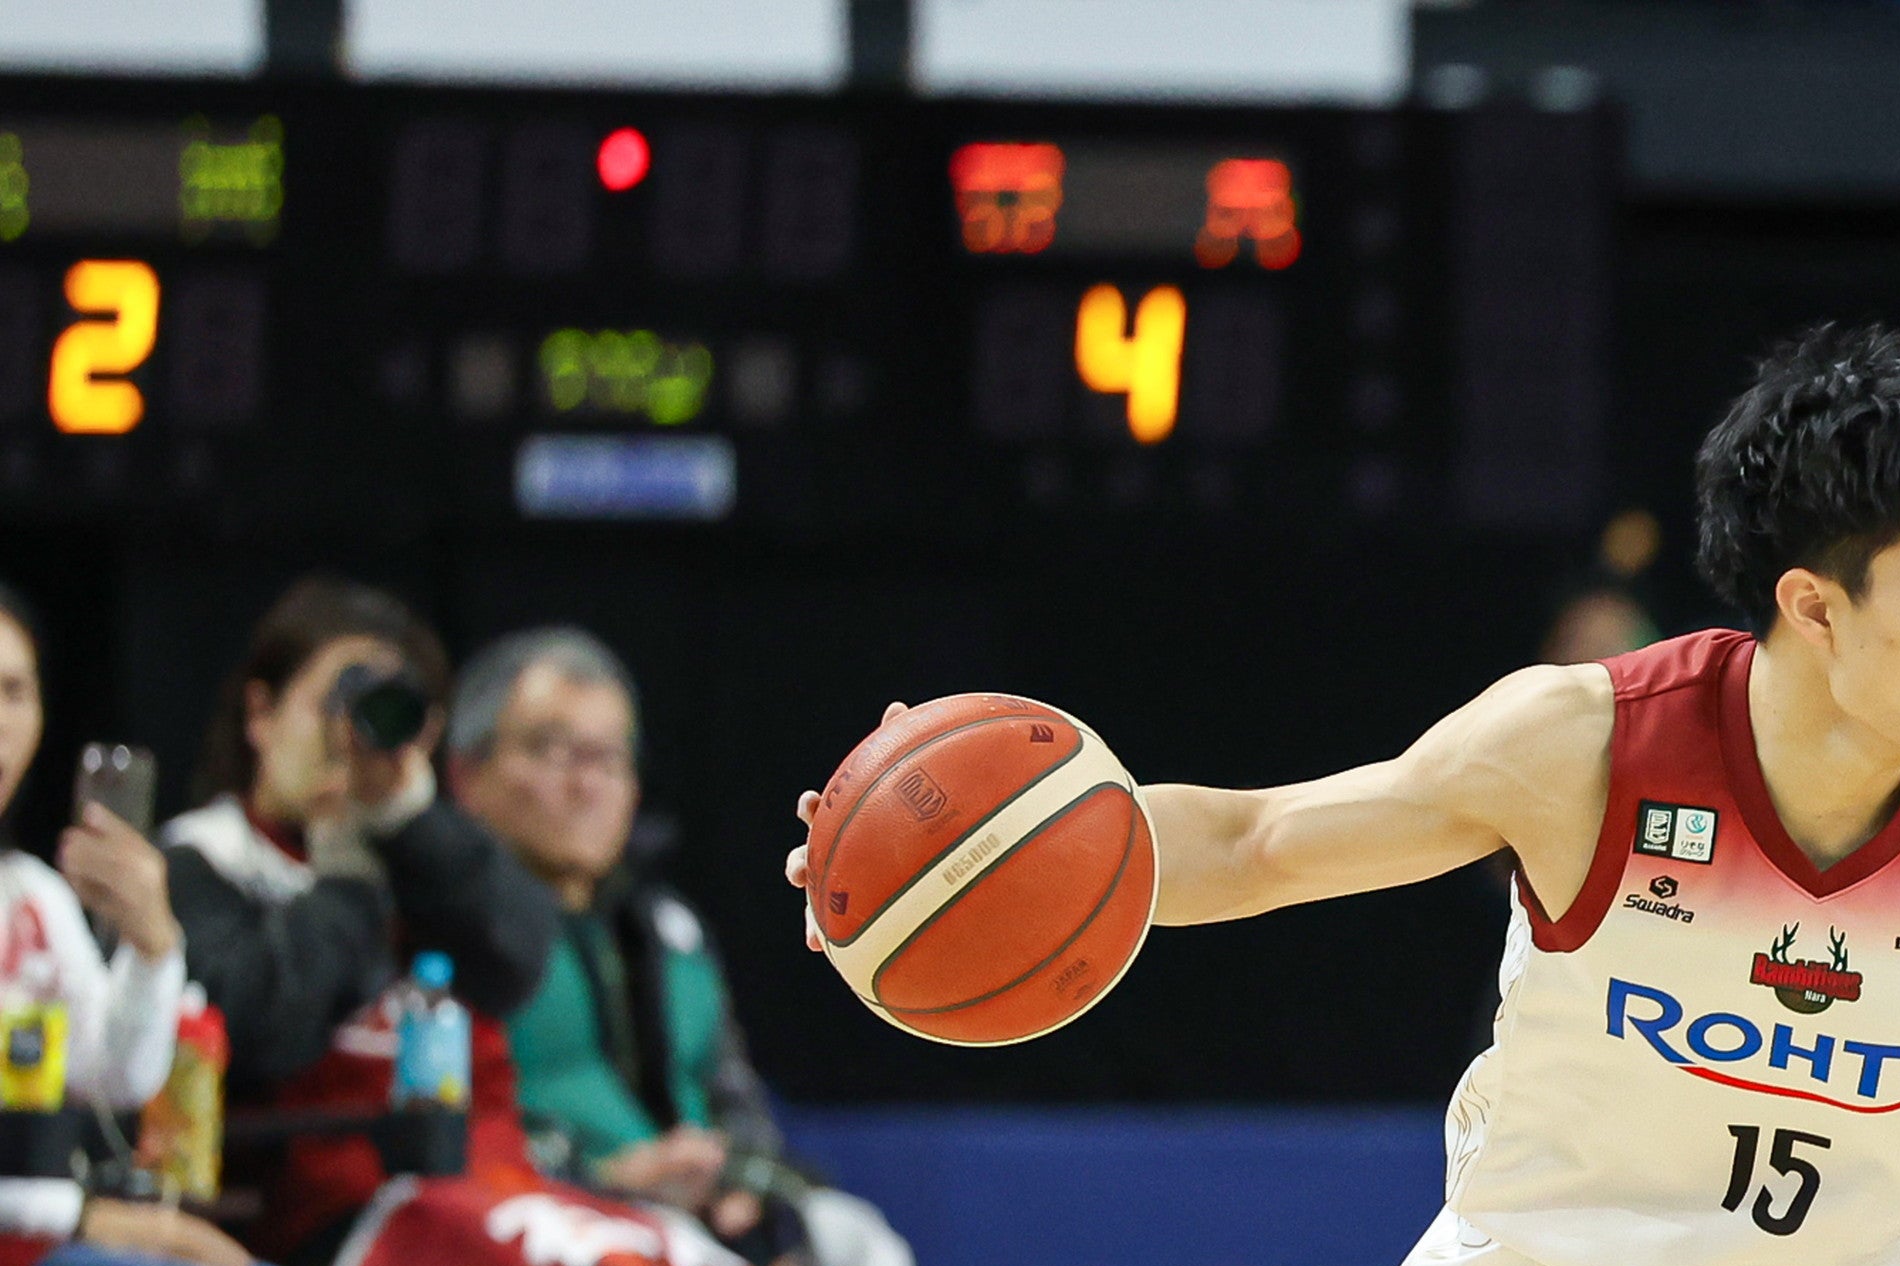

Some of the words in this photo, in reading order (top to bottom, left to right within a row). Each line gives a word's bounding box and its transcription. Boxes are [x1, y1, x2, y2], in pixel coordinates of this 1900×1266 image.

[49, 259, 160, 434] 2
[1074, 283, 1187, 445] 4
[1623, 894, 1695, 923] Squadra
[1804, 989, 1827, 1004] Nara
[1721, 1123, 1832, 1237] 15
